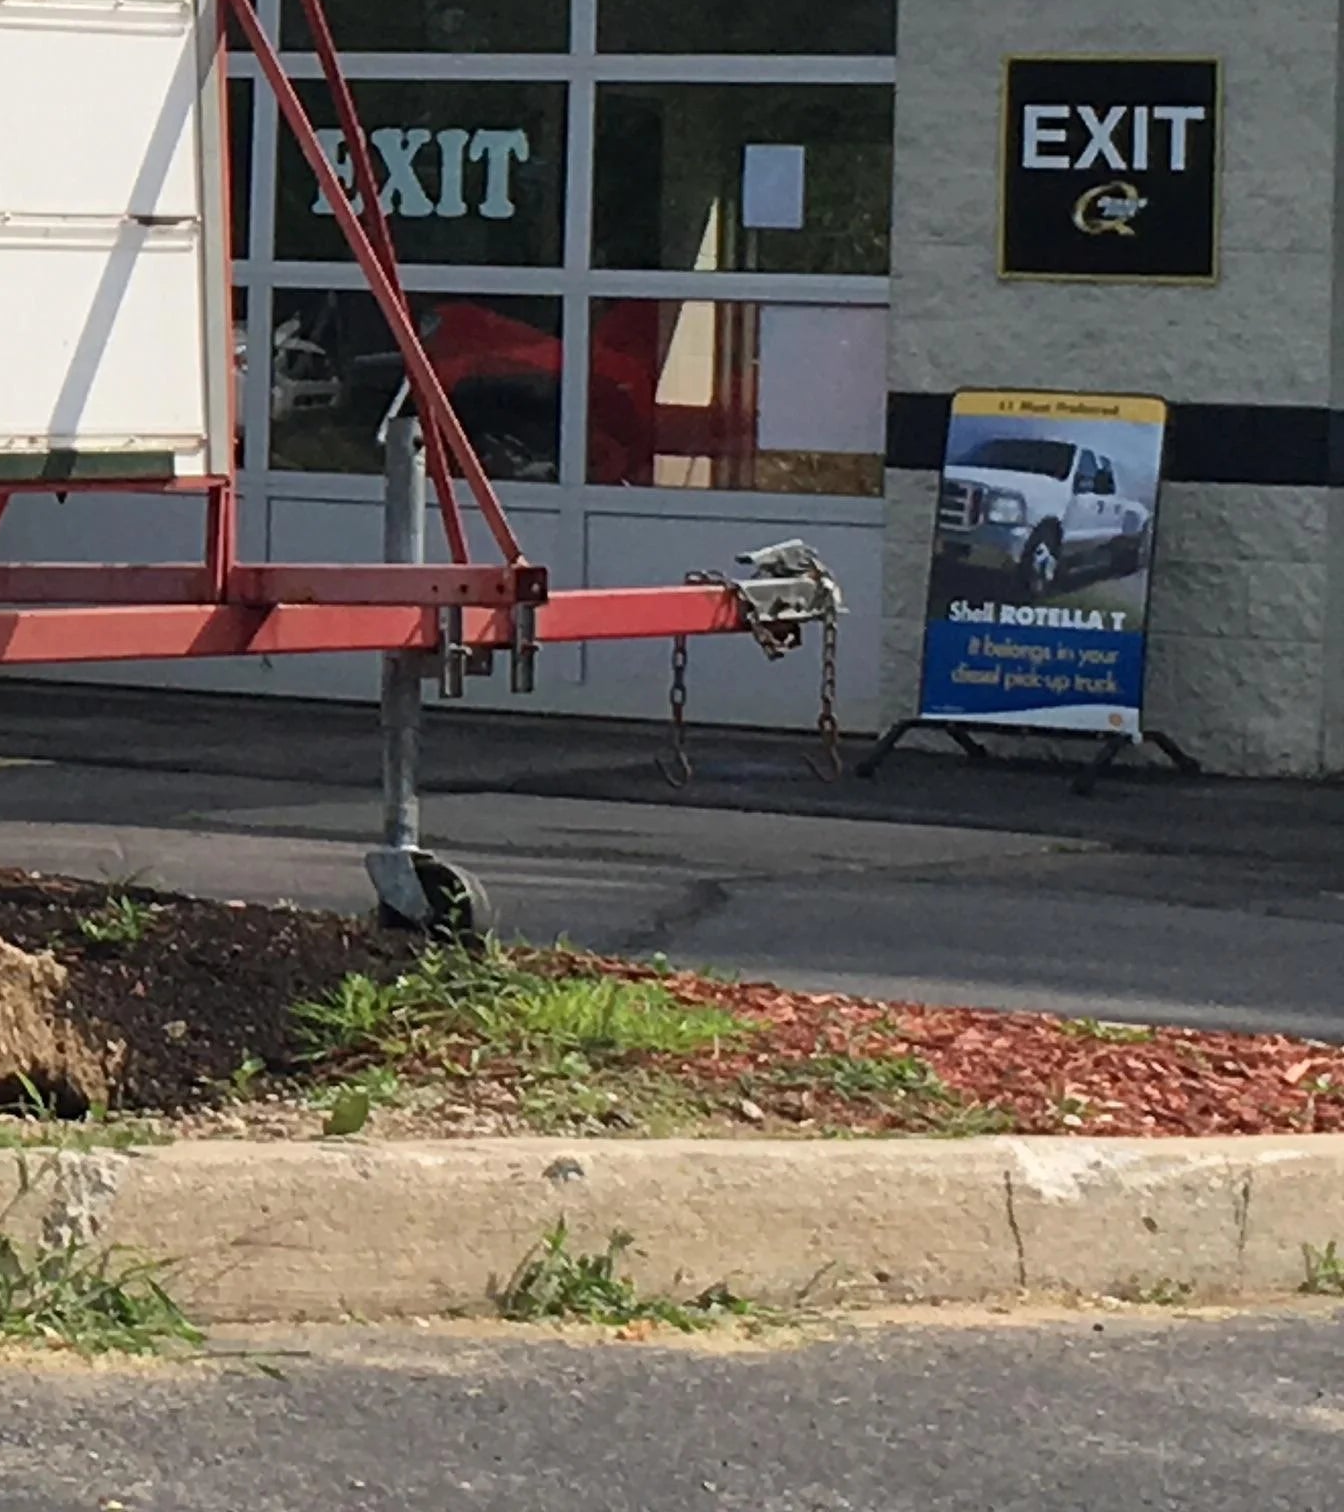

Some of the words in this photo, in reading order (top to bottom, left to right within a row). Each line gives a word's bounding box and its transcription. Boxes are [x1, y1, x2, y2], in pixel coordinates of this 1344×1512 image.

[1022, 104, 1206, 172] EXIT
[312, 128, 529, 219] EXIT
[949, 600, 995, 623] Shell
[999, 604, 1104, 630] ROTELLA
[1079, 647, 1119, 667] your
